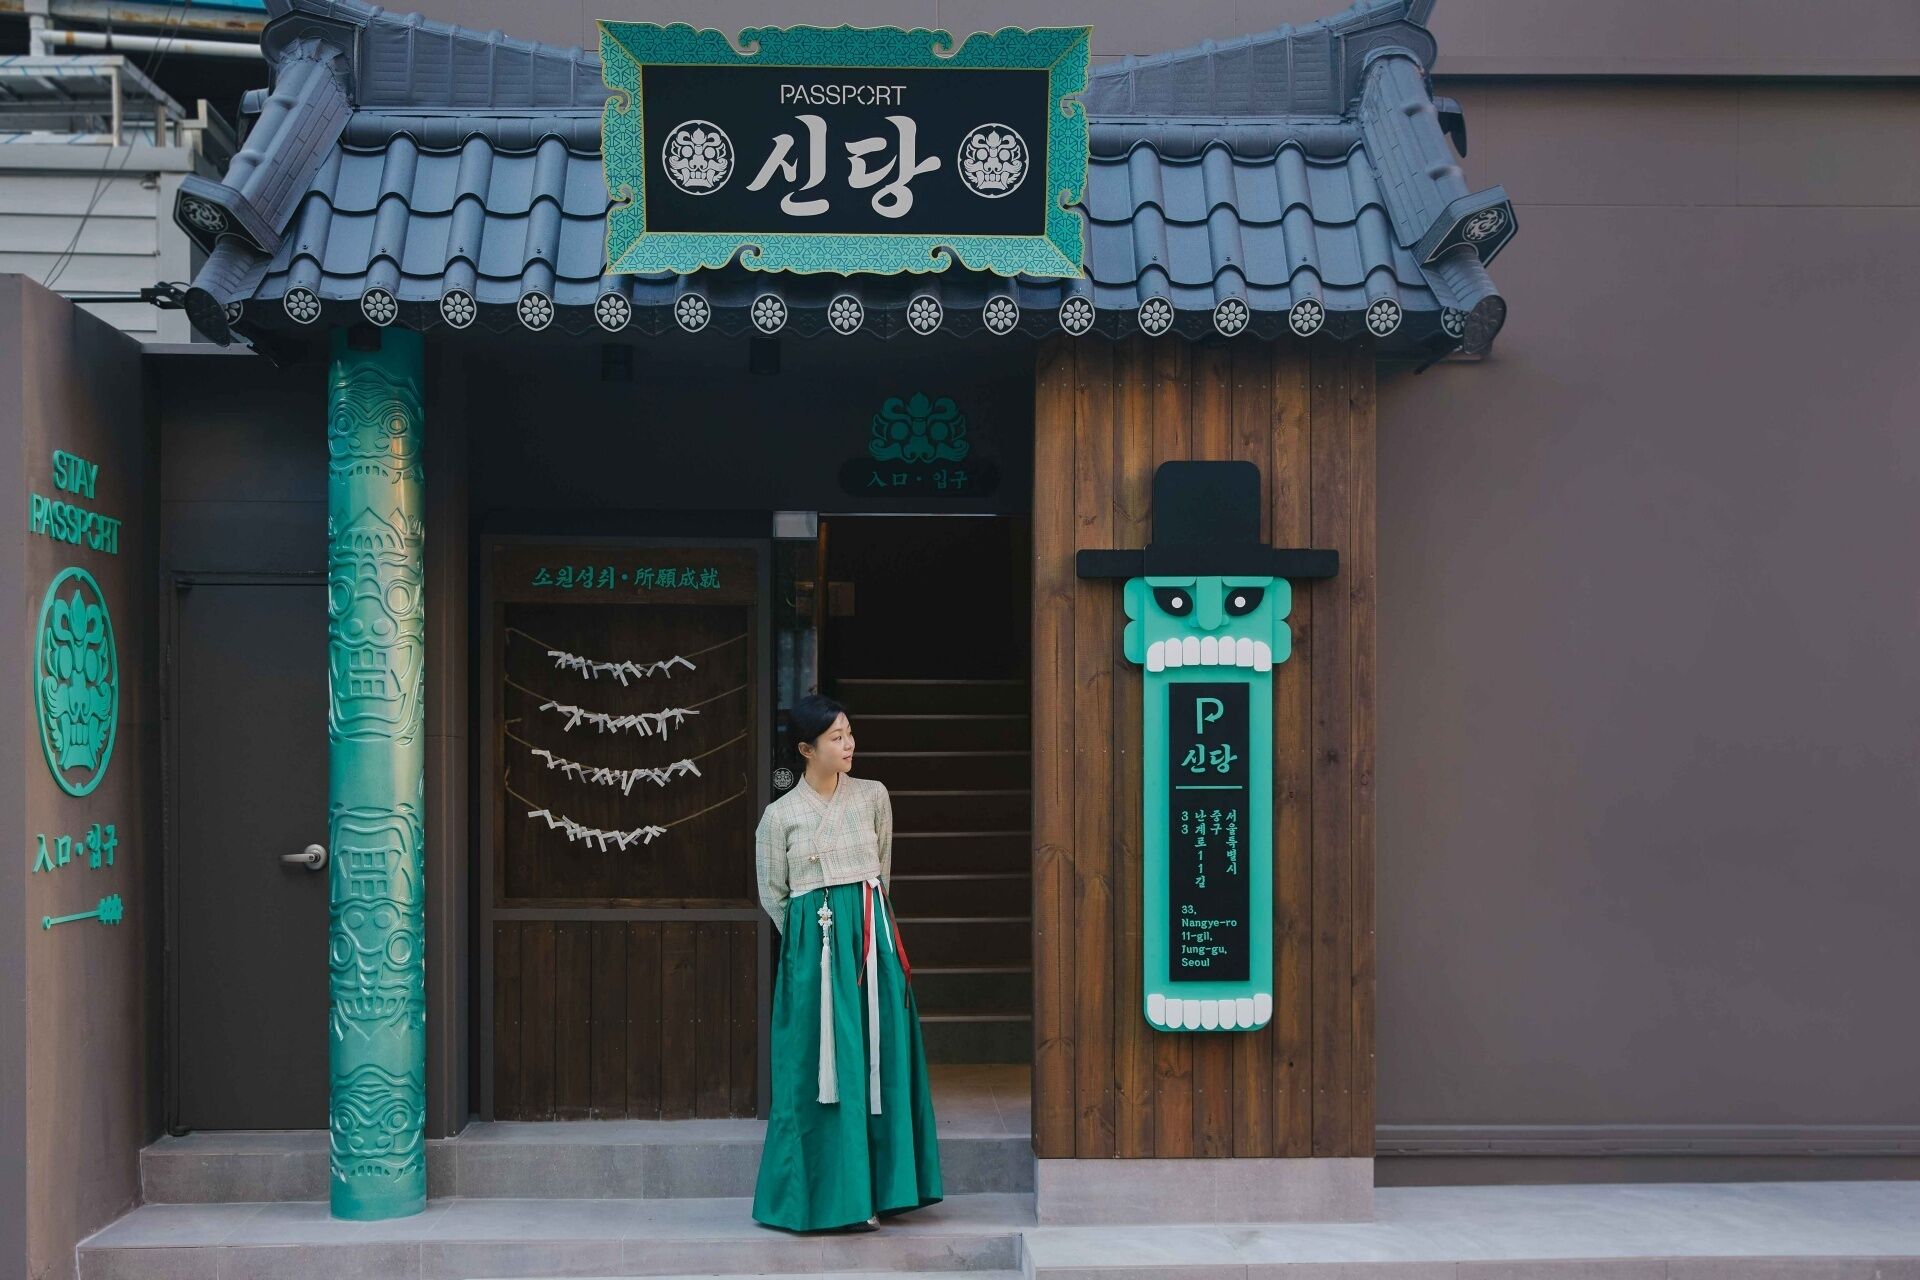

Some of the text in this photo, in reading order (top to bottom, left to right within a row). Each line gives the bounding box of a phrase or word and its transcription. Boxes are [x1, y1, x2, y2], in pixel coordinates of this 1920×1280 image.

[780, 84, 907, 105] PASSPORT
[745, 114, 942, 219] 신당
[53, 449, 98, 499] STAY
[29, 492, 121, 554] PASSPORT
[1196, 697, 1224, 735] P
[1180, 743, 1238, 774] 신당
[1209, 809, 1223, 836] 중구
[1225, 809, 1238, 875] 서울특별시
[1181, 904, 1197, 915] 33,
[1181, 918, 1238, 930] Nangye-ro
[1181, 931, 1213, 943] 11-gil,
[1181, 944, 1228, 956] Jung-gu,
[1181, 957, 1210, 967] Seoul
